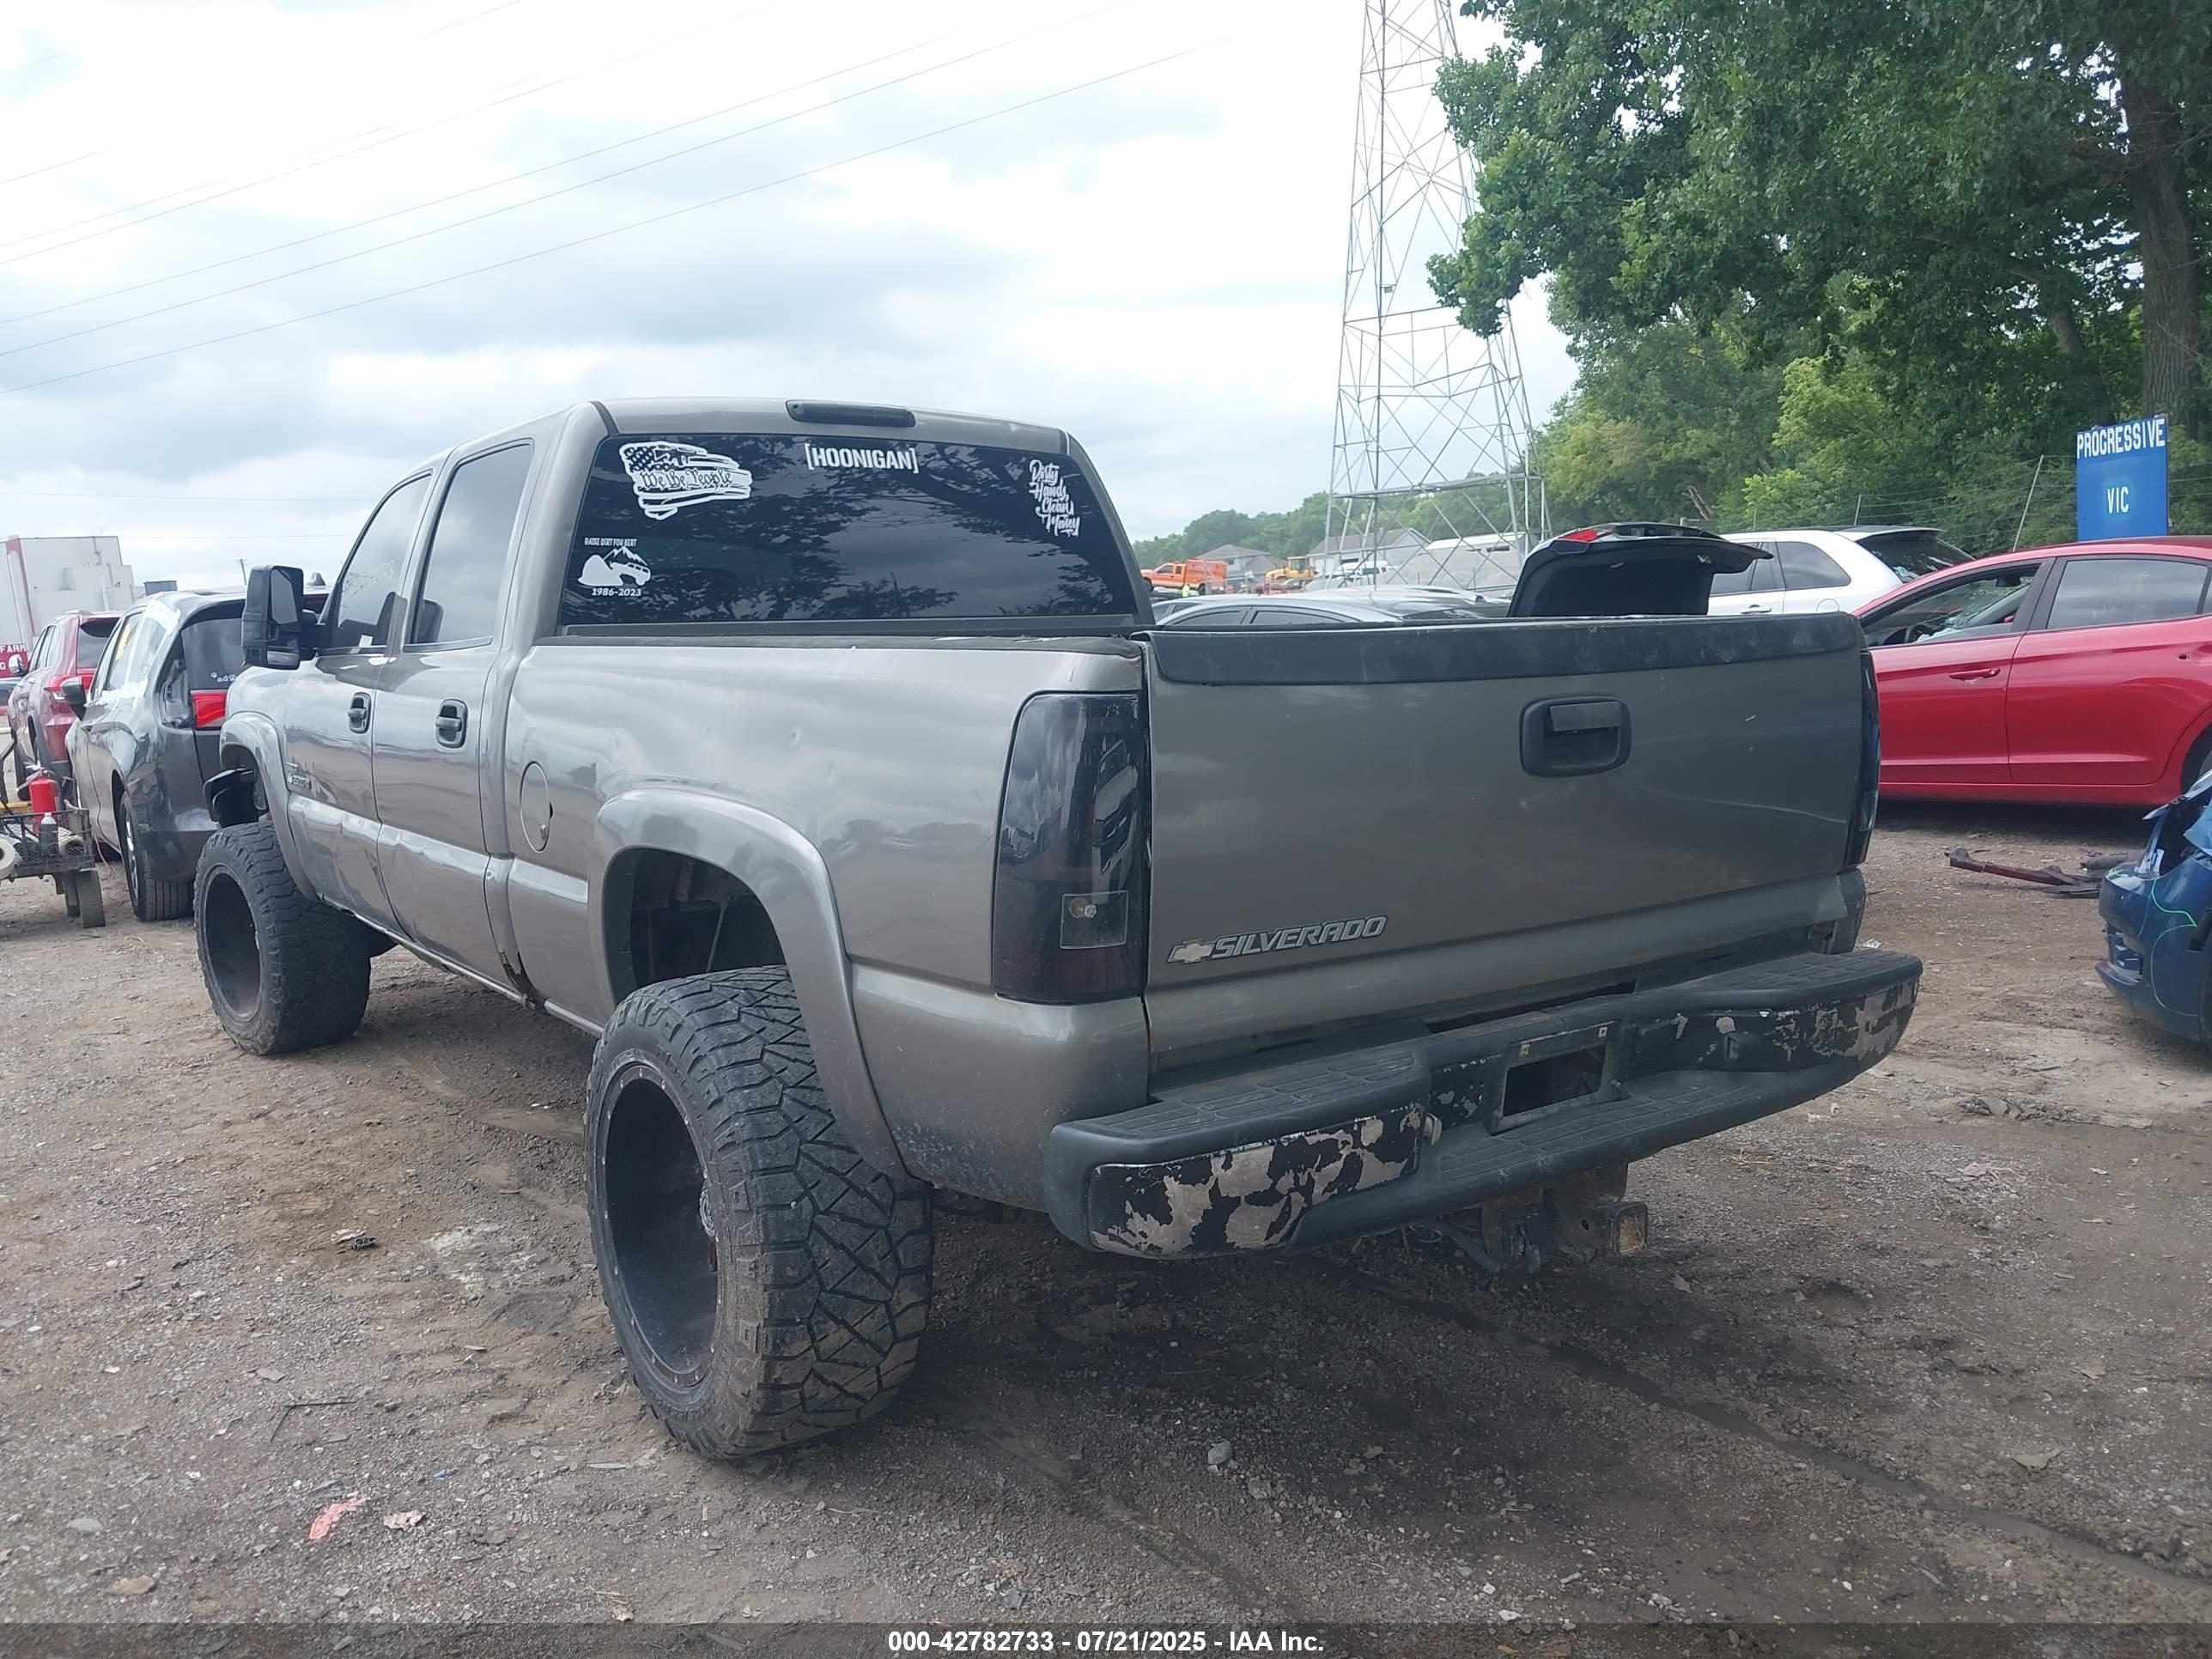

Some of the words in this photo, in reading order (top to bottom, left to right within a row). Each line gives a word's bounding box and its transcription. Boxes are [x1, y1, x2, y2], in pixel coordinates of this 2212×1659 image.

[2076, 418, 2166, 459] PROGRESSIVE
[640, 471, 664, 488] We
[687, 468, 733, 489] People
[1030, 459, 1060, 486] Dirty
[1042, 497, 1074, 515] Clean
[2106, 486, 2130, 514] VIC
[1036, 506, 1080, 538] Money
[584, 538, 600, 546] RAISE
[601, 538, 613, 546] DIRT
[0, 644, 27, 653] FARM
[1211, 915, 1388, 959] SILVERADO
